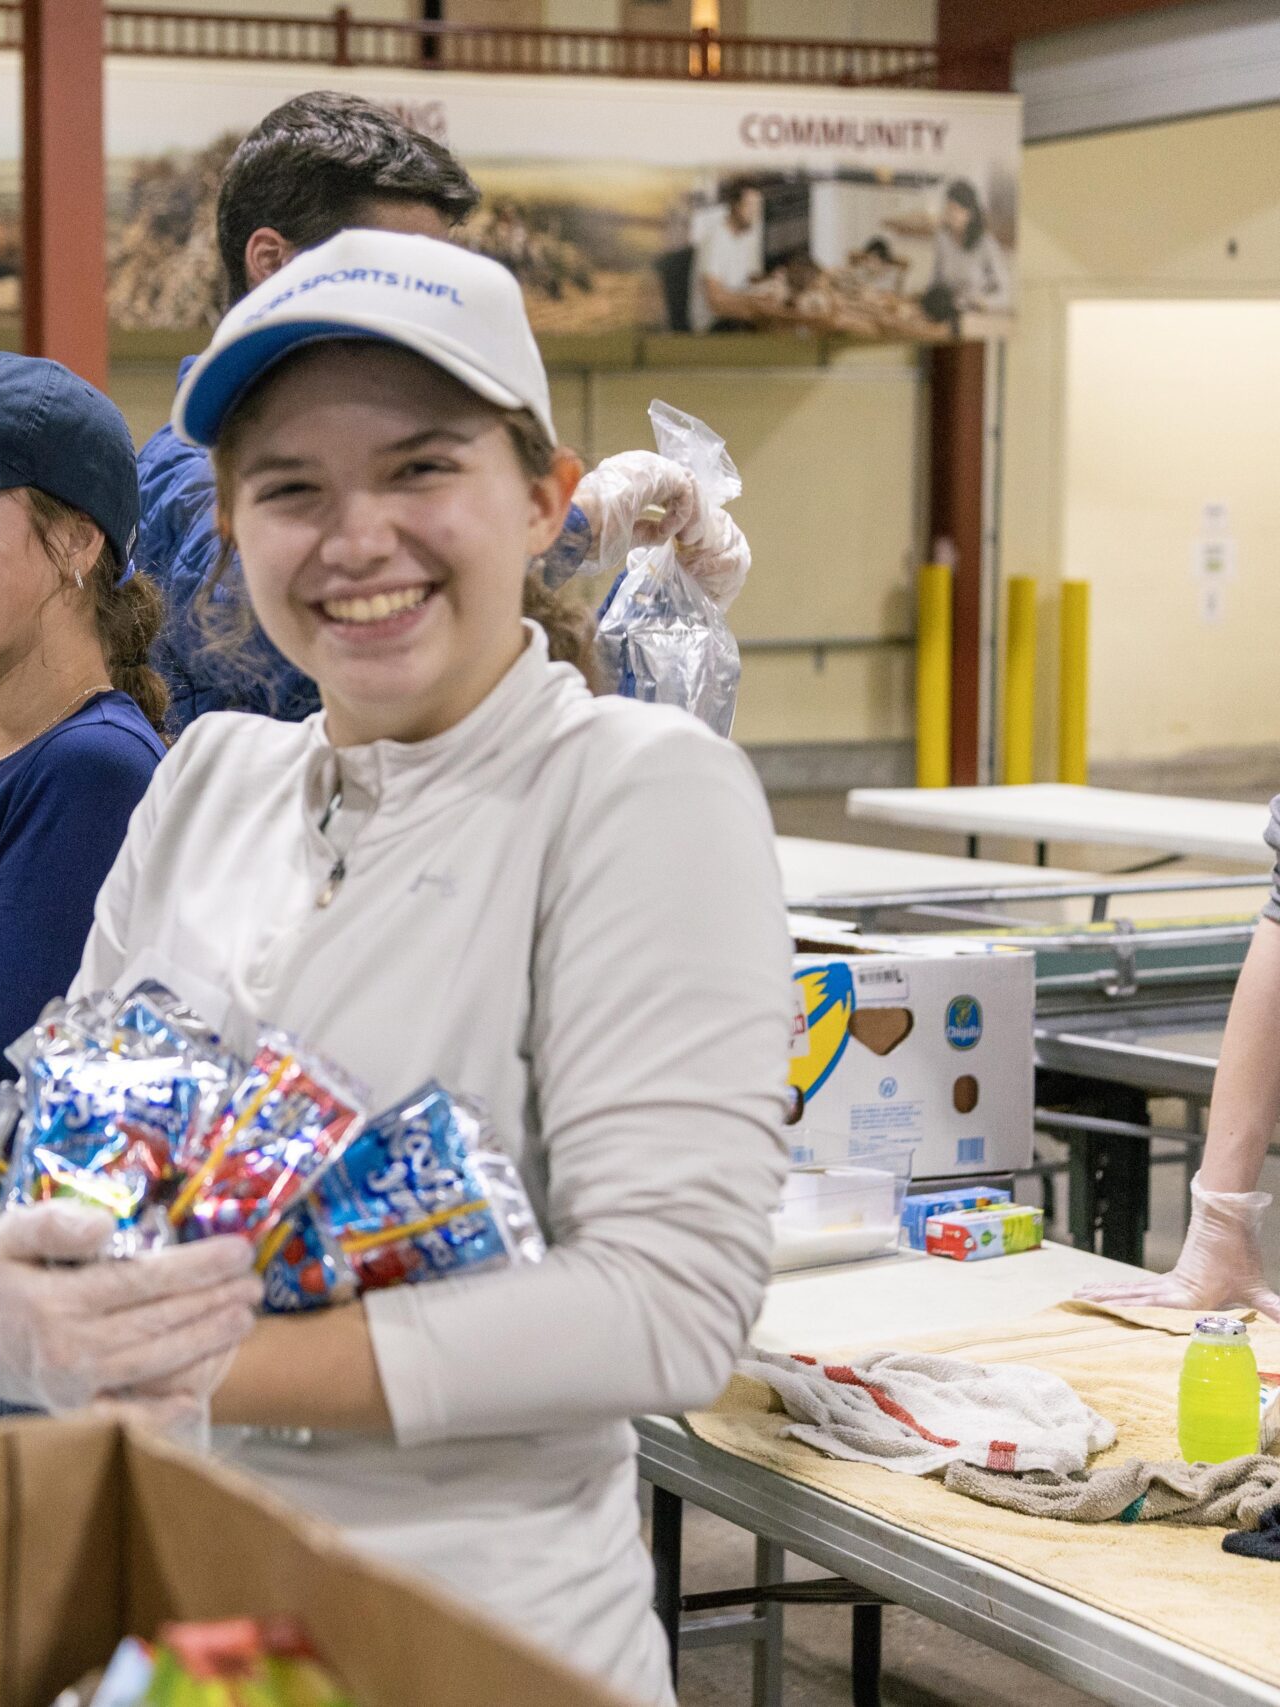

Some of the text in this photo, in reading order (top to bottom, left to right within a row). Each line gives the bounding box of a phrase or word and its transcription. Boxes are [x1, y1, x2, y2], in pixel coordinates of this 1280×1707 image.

[739, 111, 949, 154] COMMUNITY
[299, 268, 399, 294] SPORTS
[416, 279, 465, 308] NFL
